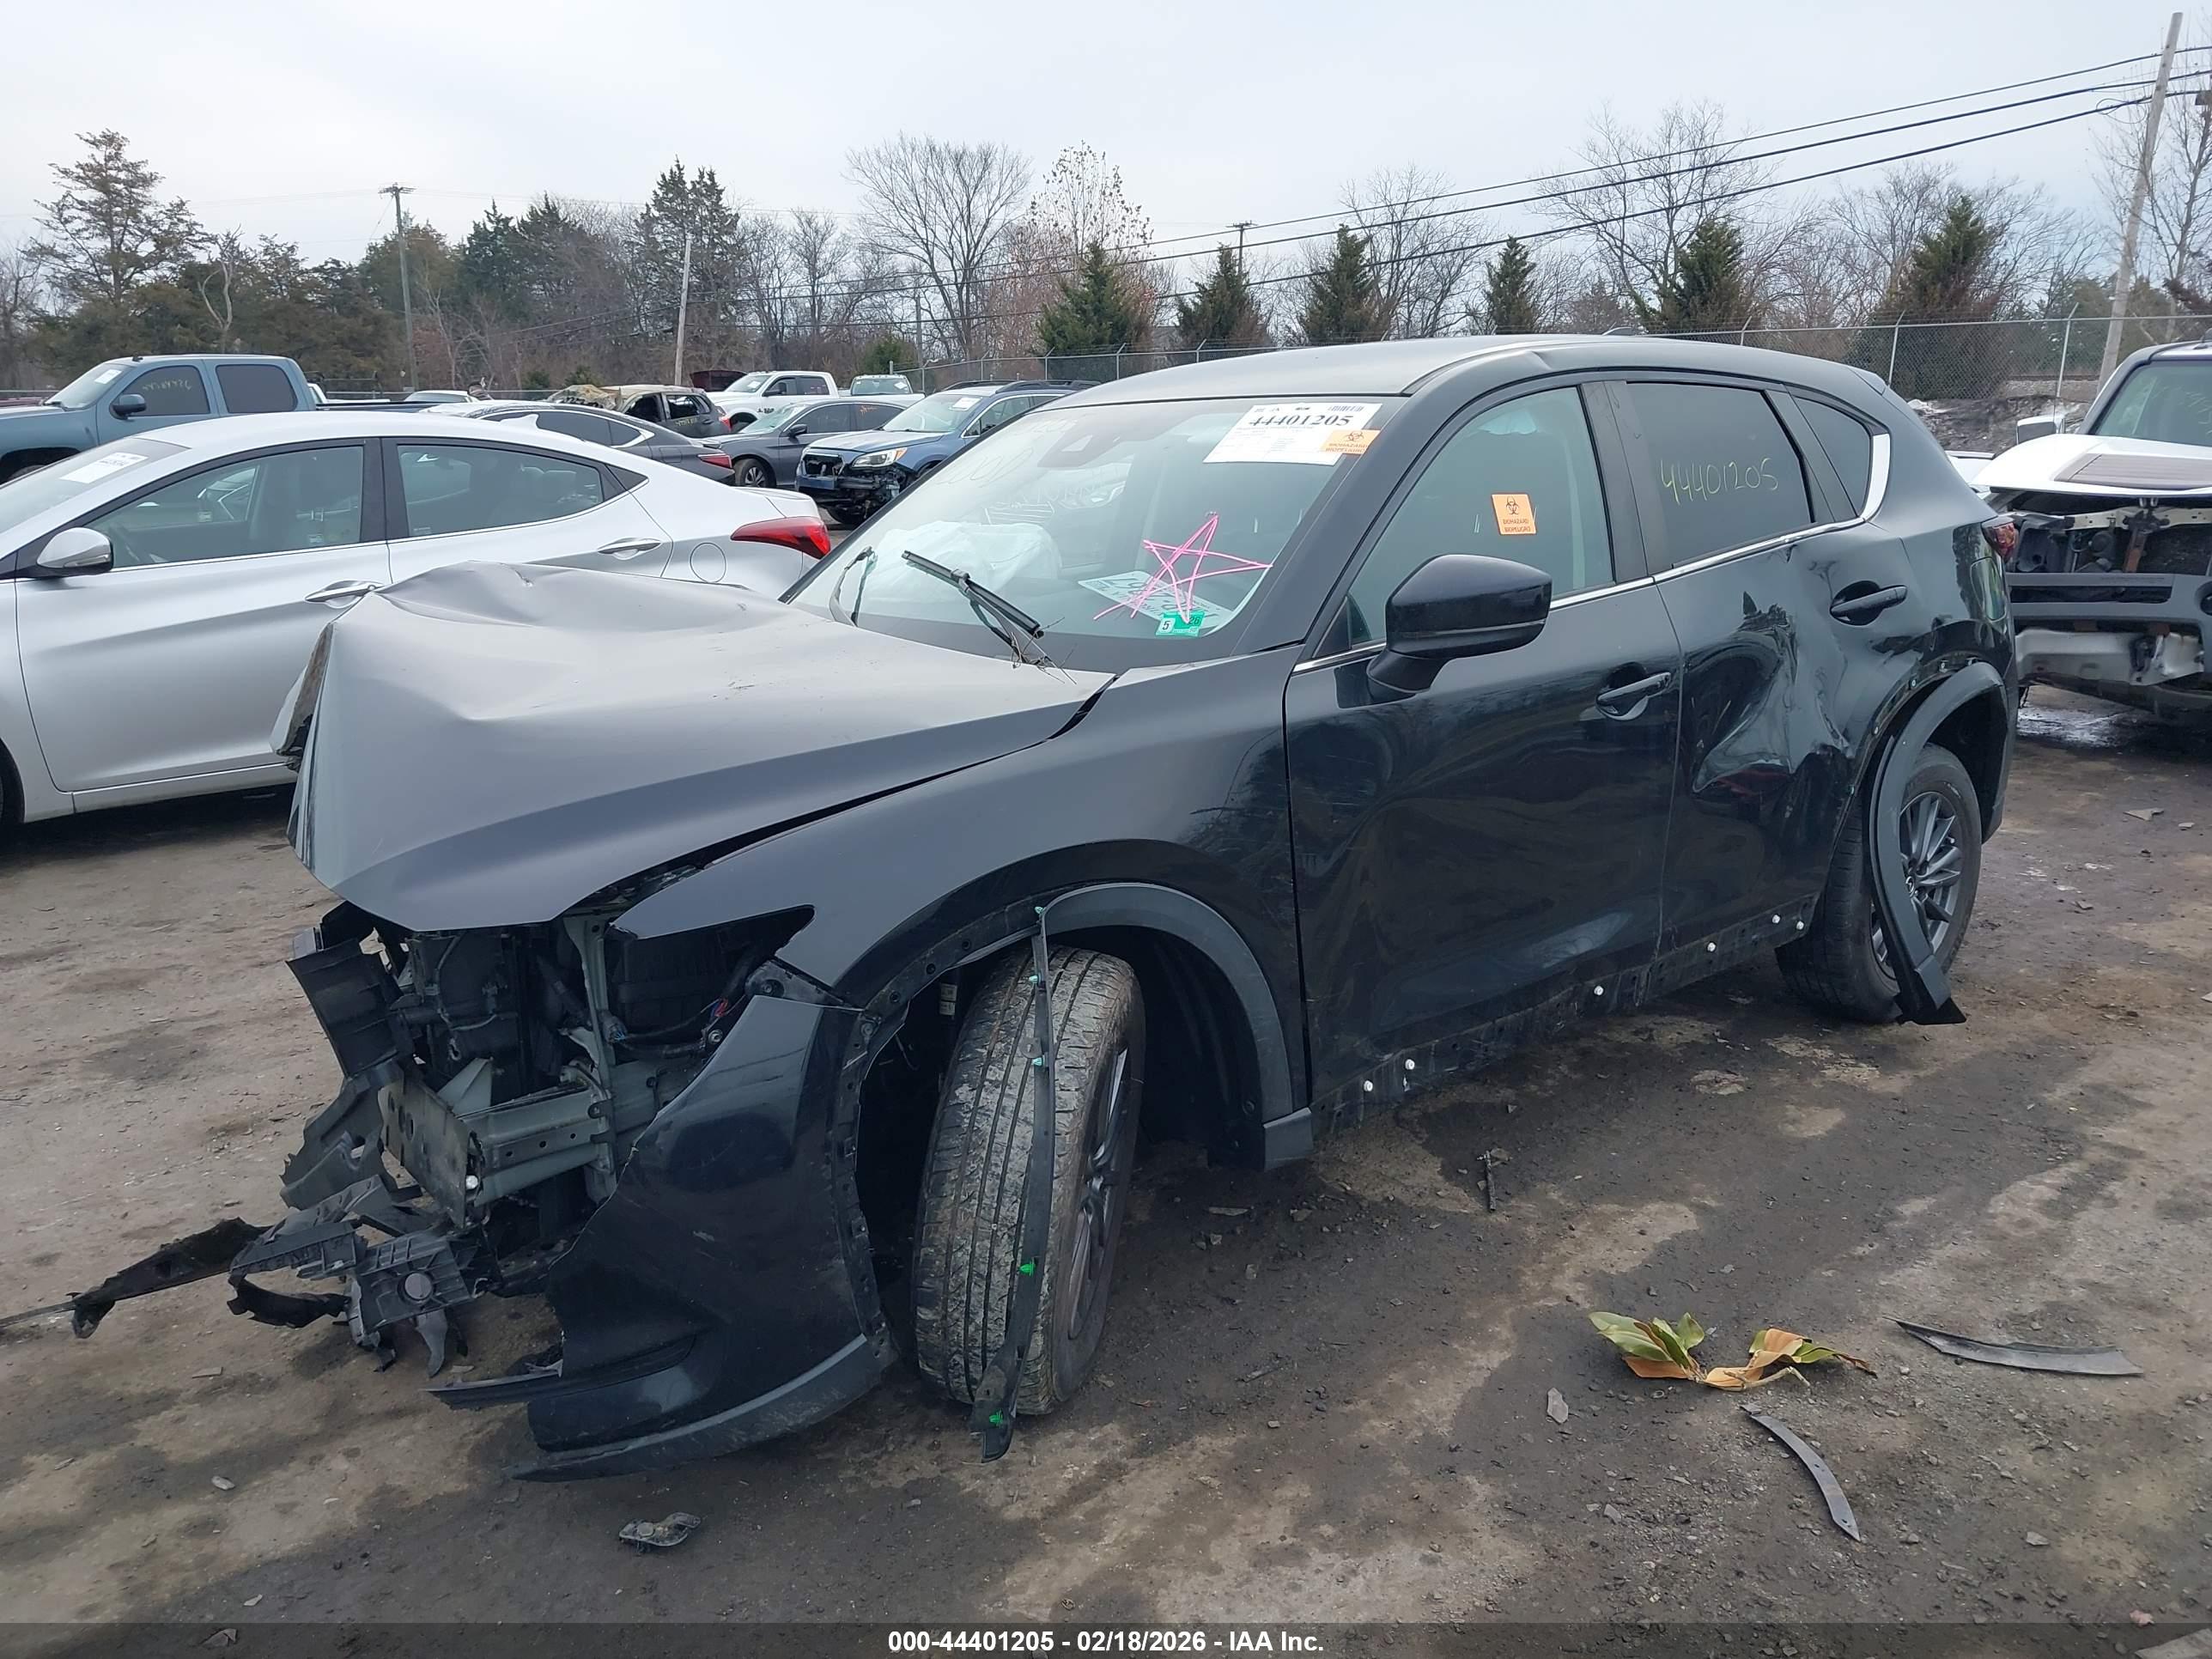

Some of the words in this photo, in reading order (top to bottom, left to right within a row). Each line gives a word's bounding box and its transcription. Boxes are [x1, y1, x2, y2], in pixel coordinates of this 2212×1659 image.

[1249, 415, 1354, 427] 44401205
[1660, 457, 1778, 505] 44401205
[1162, 620, 1171, 631] 5
[1189, 616, 1202, 627] 26
